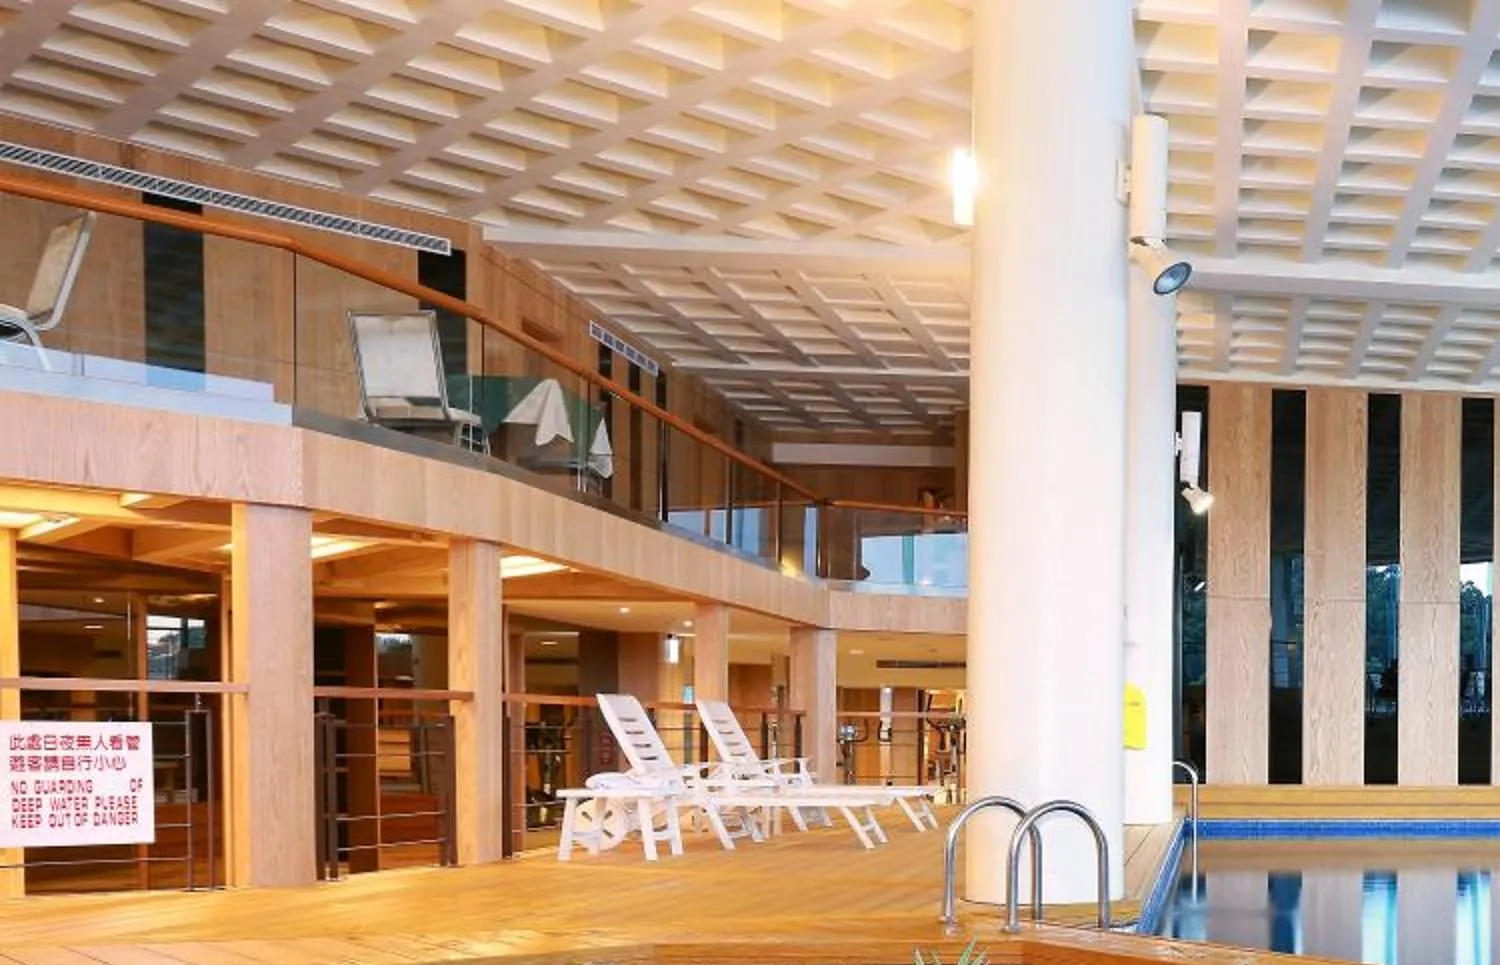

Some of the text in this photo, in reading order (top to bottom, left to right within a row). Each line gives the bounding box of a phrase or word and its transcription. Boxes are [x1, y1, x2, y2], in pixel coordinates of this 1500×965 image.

[11, 778, 143, 794] NO GUARDING OF
[12, 795, 137, 812] DEEP WATER PLEASE
[12, 811, 138, 829] KEEP OUT OF DANGER
